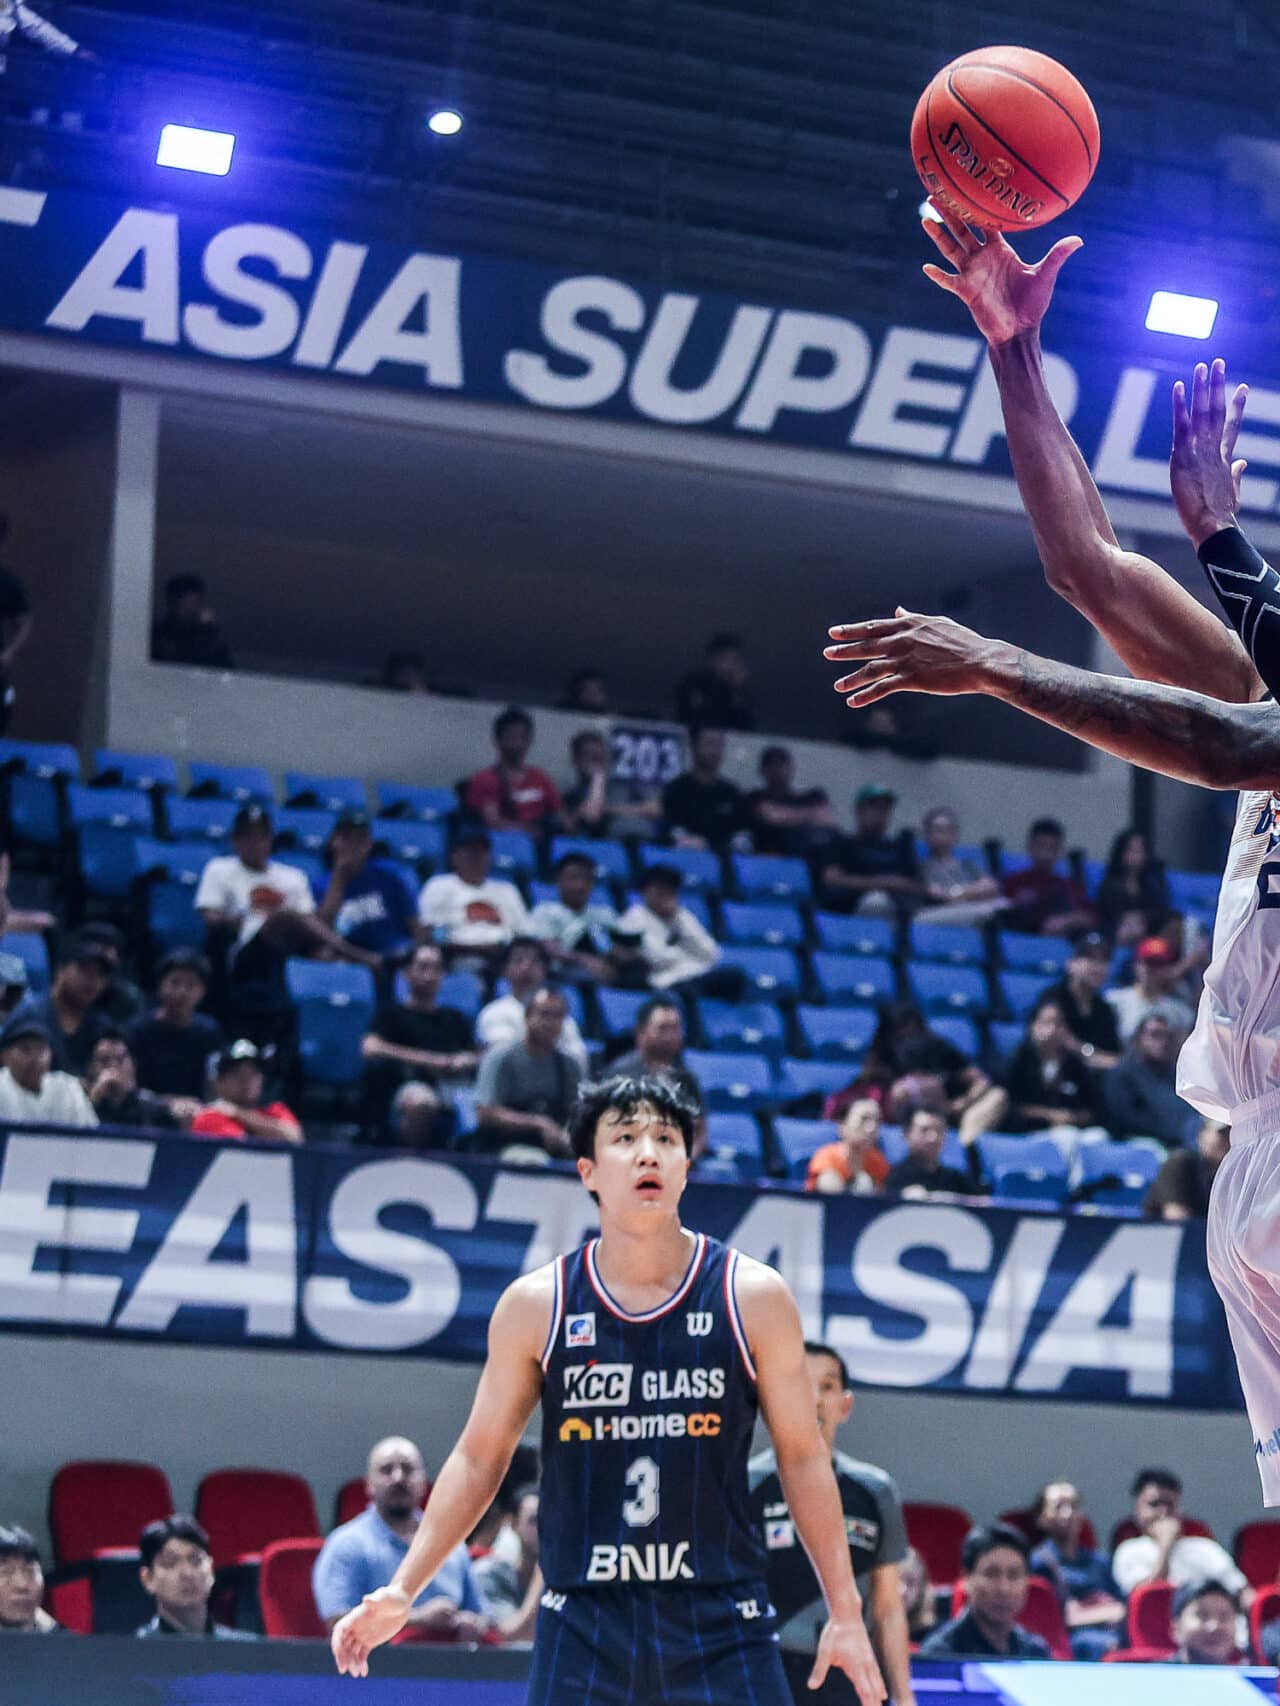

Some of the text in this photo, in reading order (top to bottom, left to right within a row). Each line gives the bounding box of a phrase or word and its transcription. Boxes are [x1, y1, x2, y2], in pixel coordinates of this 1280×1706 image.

[938, 121, 1038, 222] SPALDING
[46, 207, 464, 389] ASIA
[615, 734, 681, 780] 203
[563, 1360, 726, 1402] KCC GLASS
[622, 1455, 660, 1528] 3
[586, 1540, 696, 1582] BNK
